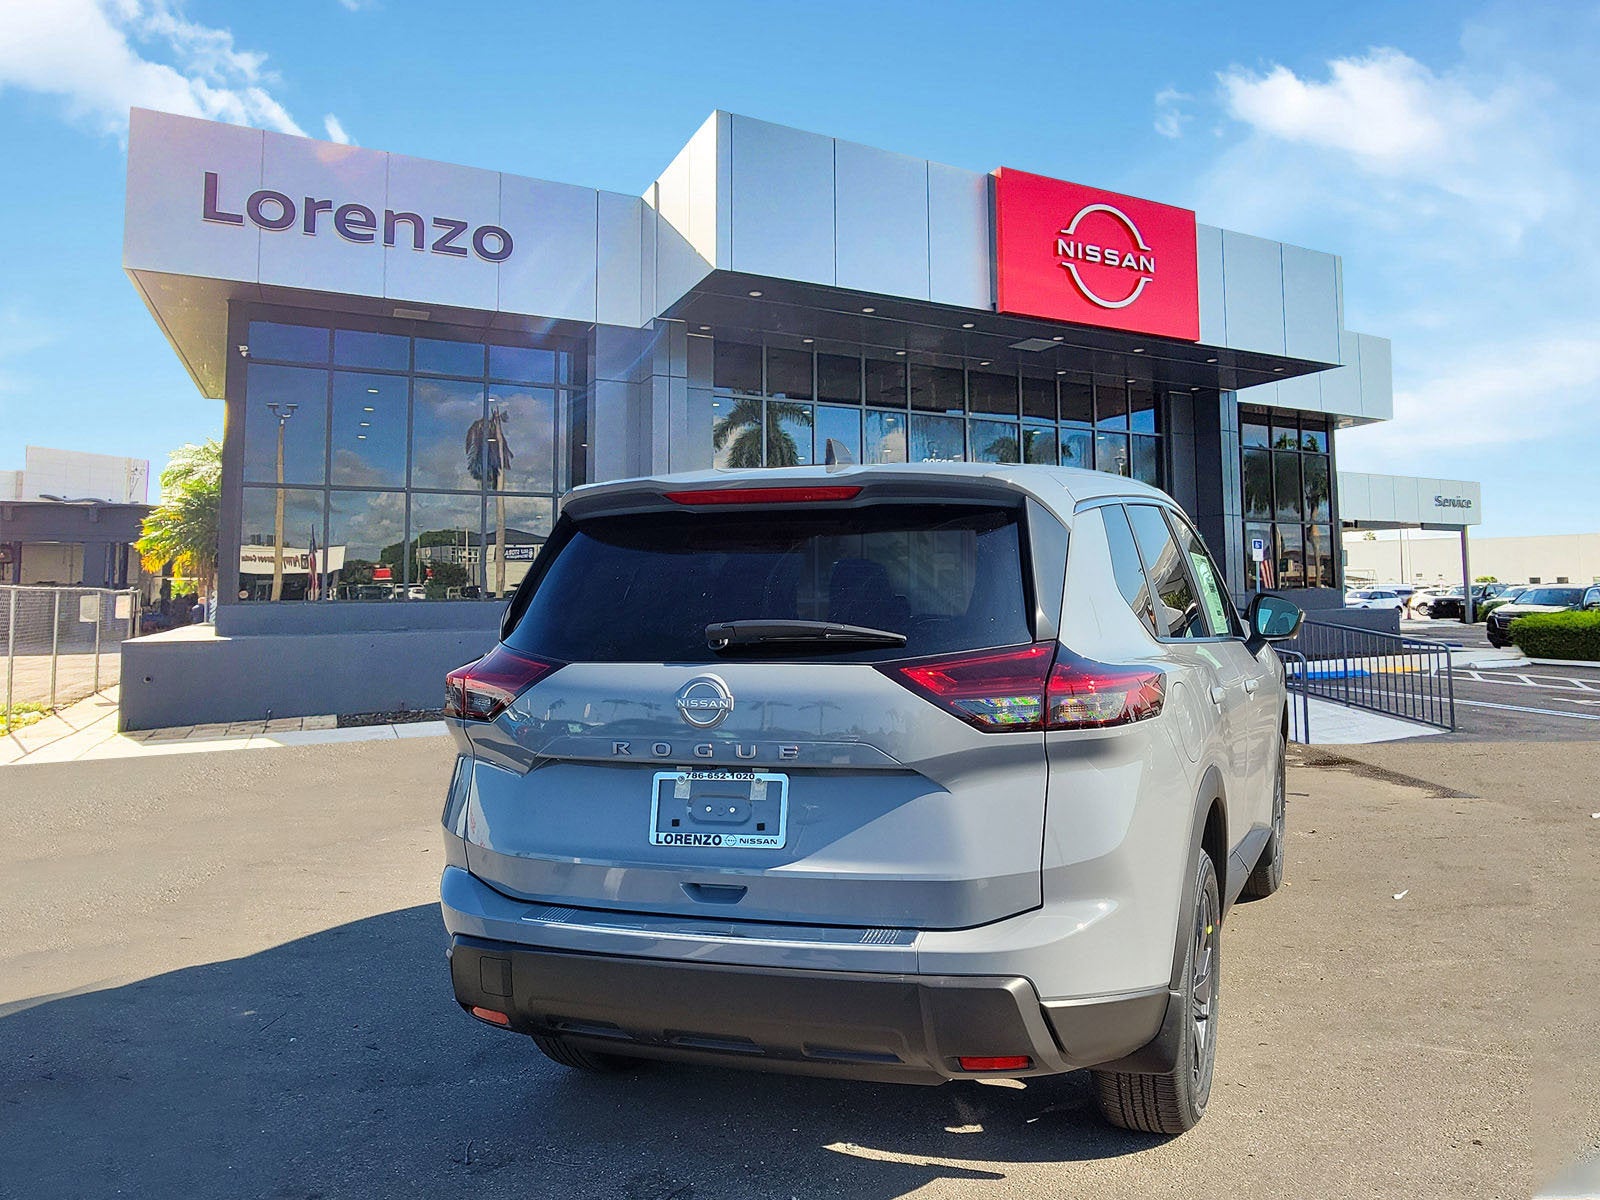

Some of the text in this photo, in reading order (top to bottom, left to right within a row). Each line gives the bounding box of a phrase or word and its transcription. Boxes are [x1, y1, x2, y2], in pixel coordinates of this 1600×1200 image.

[202, 171, 514, 262] Lorenzo
[1057, 238, 1155, 273] NISSAN
[1434, 495, 1472, 509] Service
[677, 698, 729, 708] NISSAN
[611, 740, 800, 760] ROGUE
[685, 772, 756, 780] 786-652-1020
[655, 833, 722, 846] LORENZO
[739, 837, 778, 845] NISSAN
